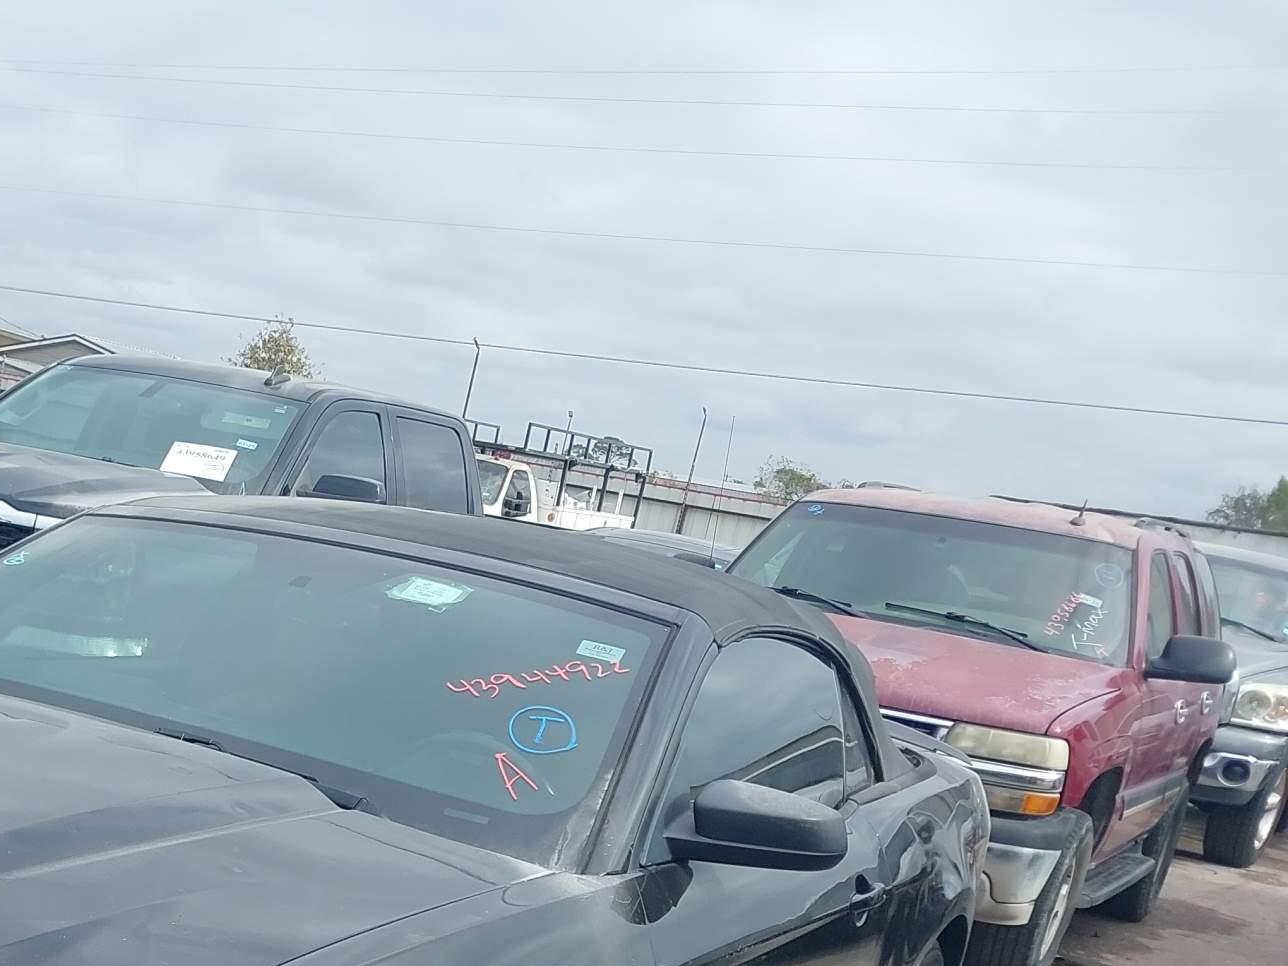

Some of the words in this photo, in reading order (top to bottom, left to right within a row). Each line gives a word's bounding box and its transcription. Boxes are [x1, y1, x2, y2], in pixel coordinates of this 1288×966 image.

[446, 660, 631, 698] 43944922
[529, 714, 565, 744] T
[495, 751, 539, 800] A
